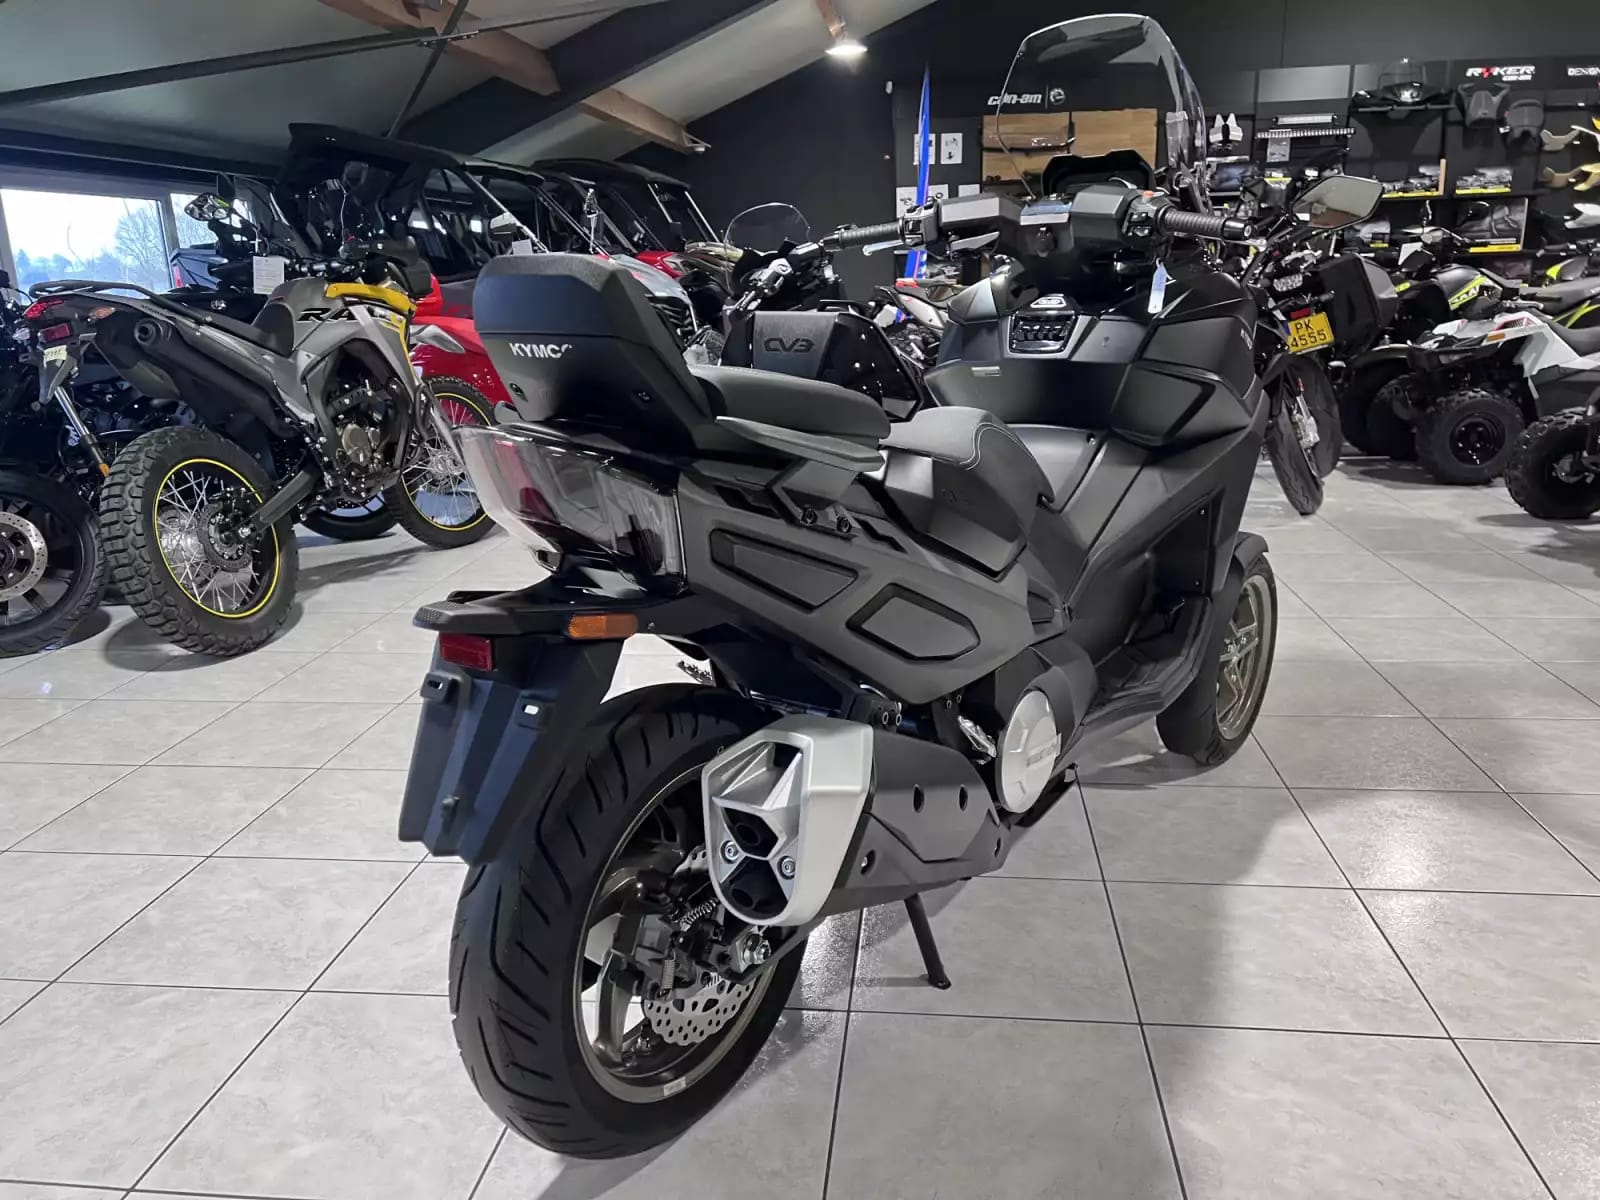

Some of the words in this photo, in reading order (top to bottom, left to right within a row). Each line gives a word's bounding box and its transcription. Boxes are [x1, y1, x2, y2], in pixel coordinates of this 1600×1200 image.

[1295, 319, 1313, 334] PK
[764, 337, 815, 353] CV3
[1291, 330, 1327, 348] 4555
